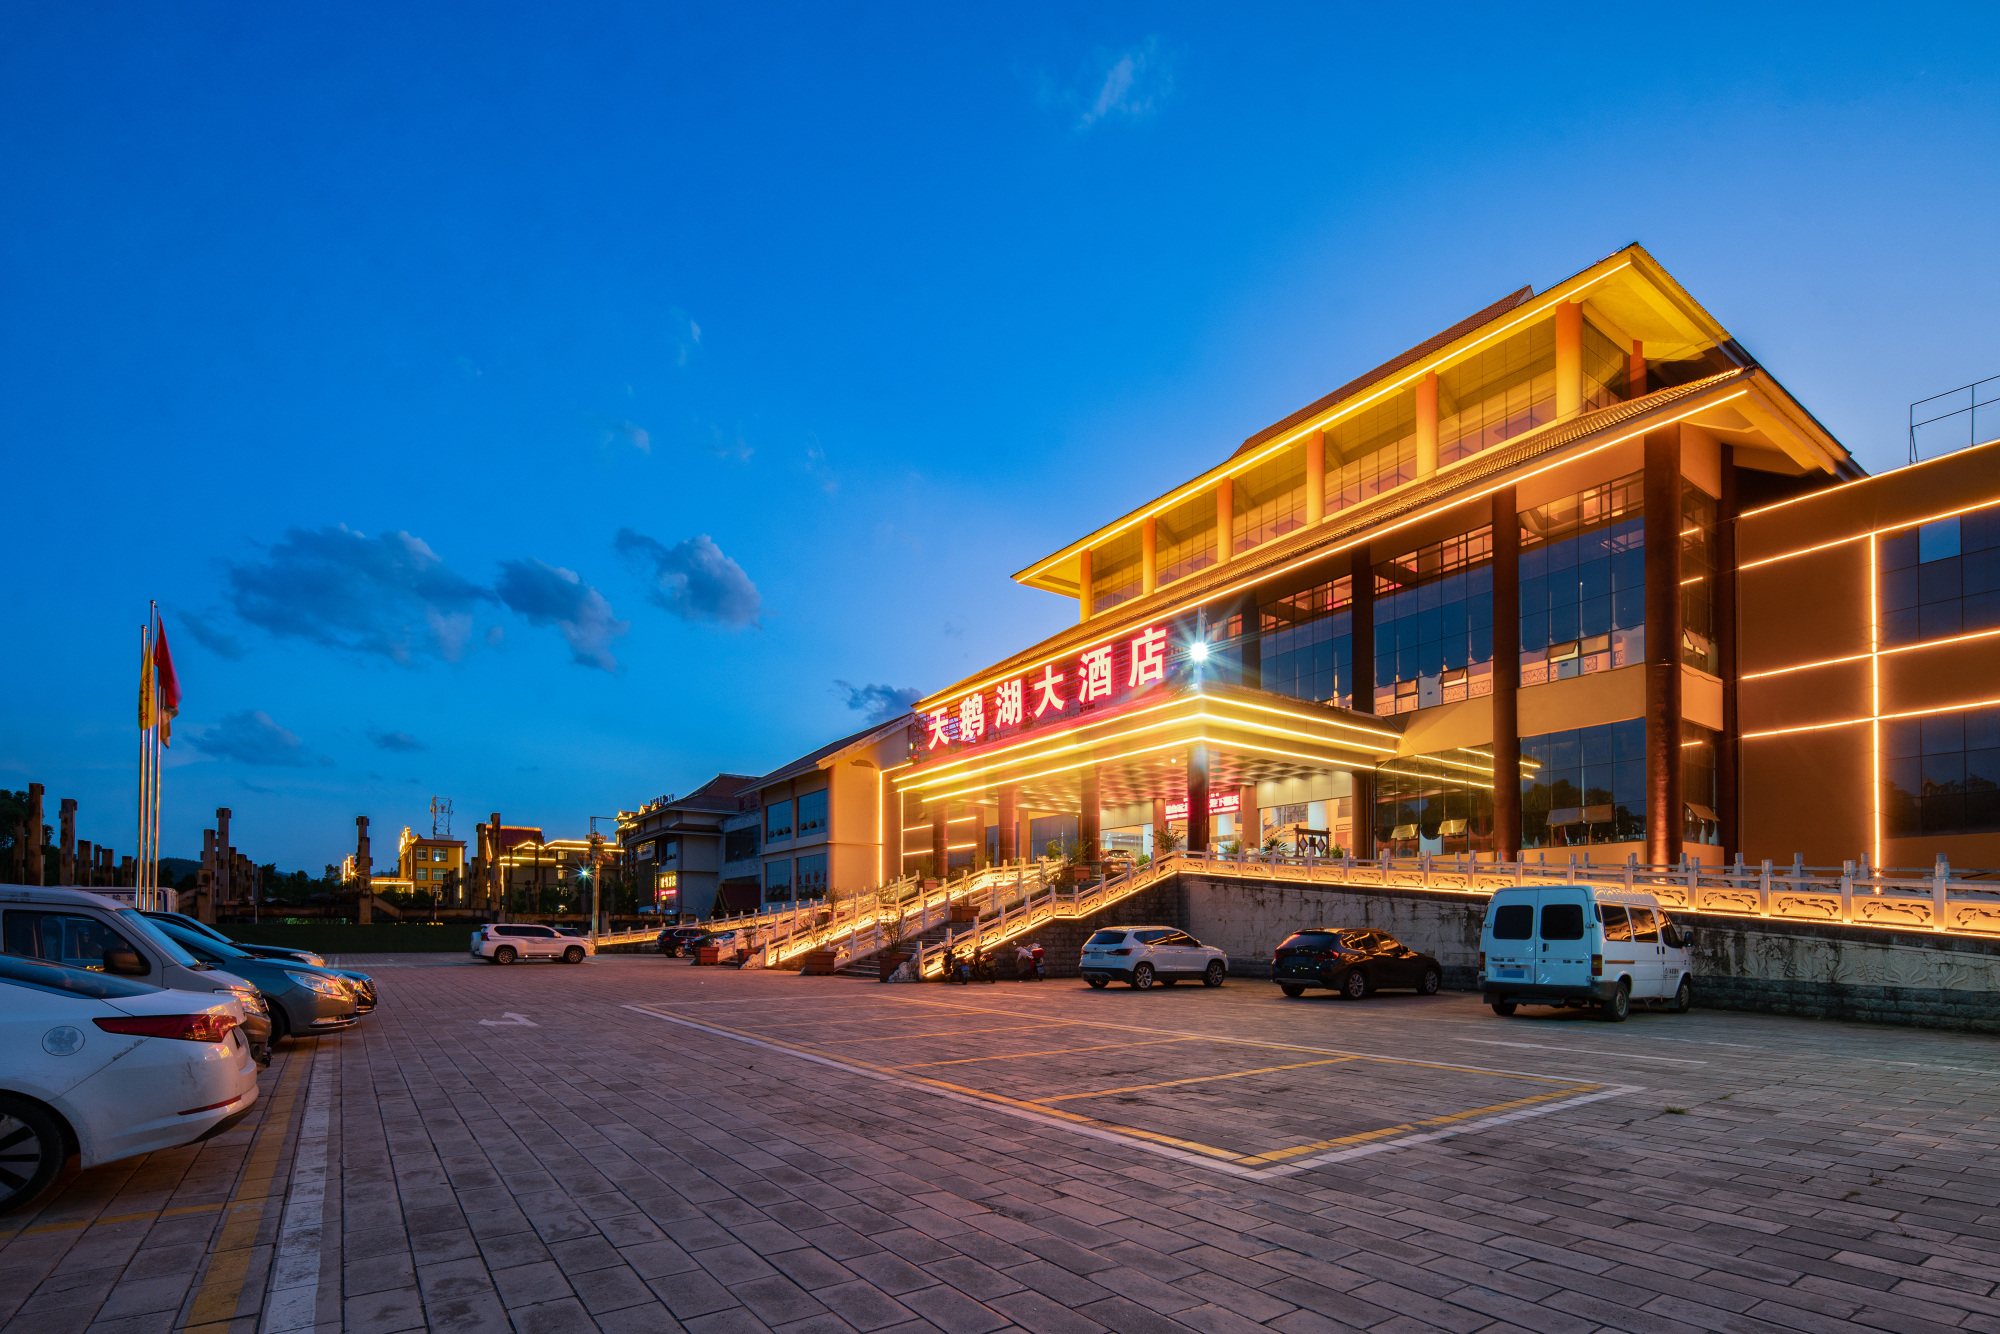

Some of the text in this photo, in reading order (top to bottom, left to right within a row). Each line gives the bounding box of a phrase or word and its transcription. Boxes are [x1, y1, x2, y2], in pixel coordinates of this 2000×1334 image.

[928, 628, 1167, 750] 天鹅湖大酒店
